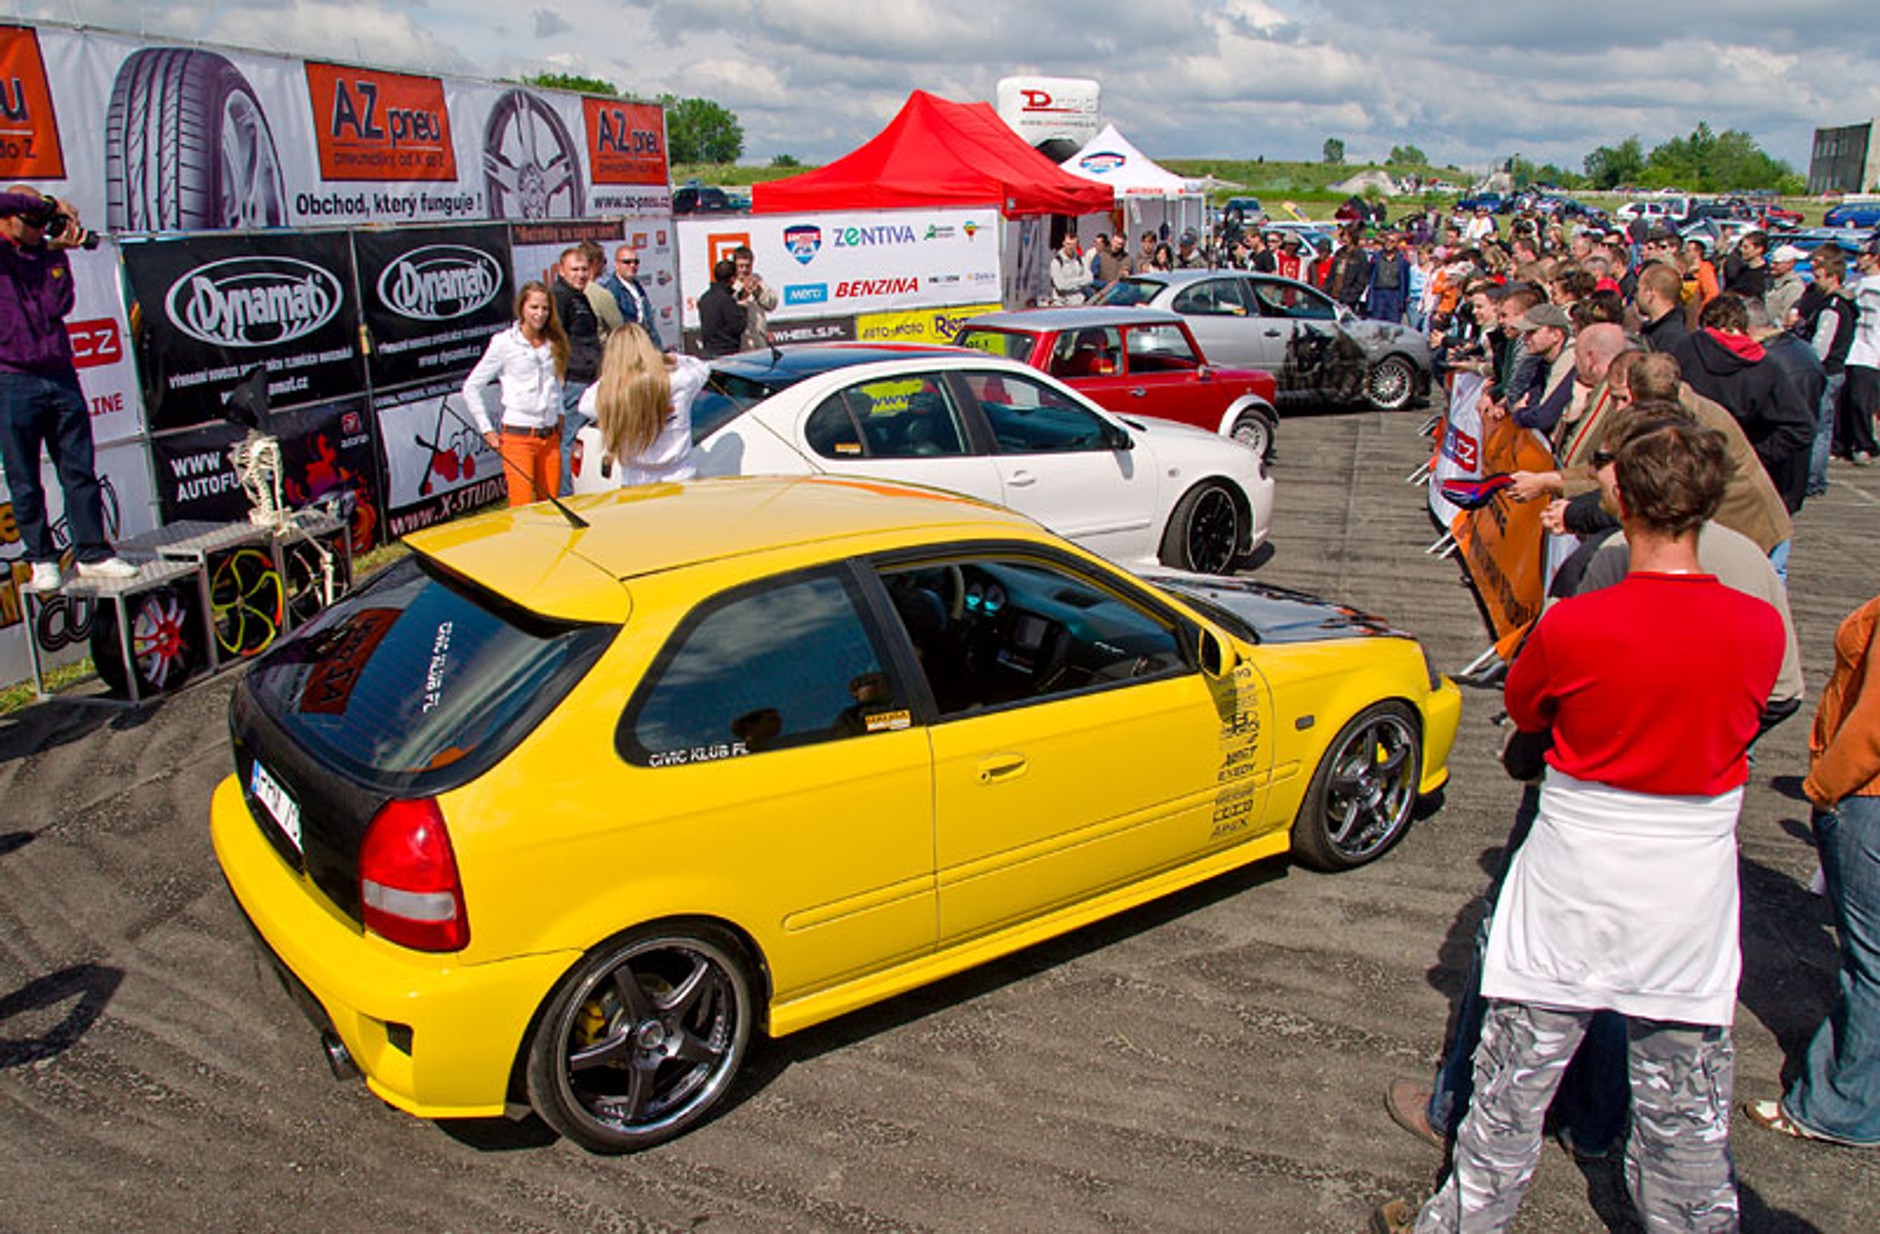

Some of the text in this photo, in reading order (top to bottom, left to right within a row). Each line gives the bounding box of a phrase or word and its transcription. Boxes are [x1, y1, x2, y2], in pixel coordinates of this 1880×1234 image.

[0, 77, 29, 121] u
[332, 79, 442, 148] AZ pneu
[598, 107, 630, 152] AZ
[24, 138, 37, 158] Z
[296, 192, 370, 217] Obchod,
[373, 192, 417, 217] který
[421, 191, 474, 216] funguje
[400, 257, 487, 314] Dynamat
[835, 277, 919, 298] BENZINA
[192, 272, 319, 340] Dynamat
[91, 392, 125, 416] INE
[170, 451, 221, 478] WWW
[176, 471, 242, 503] AUTOFU
[690, 744, 729, 762] KLUB
